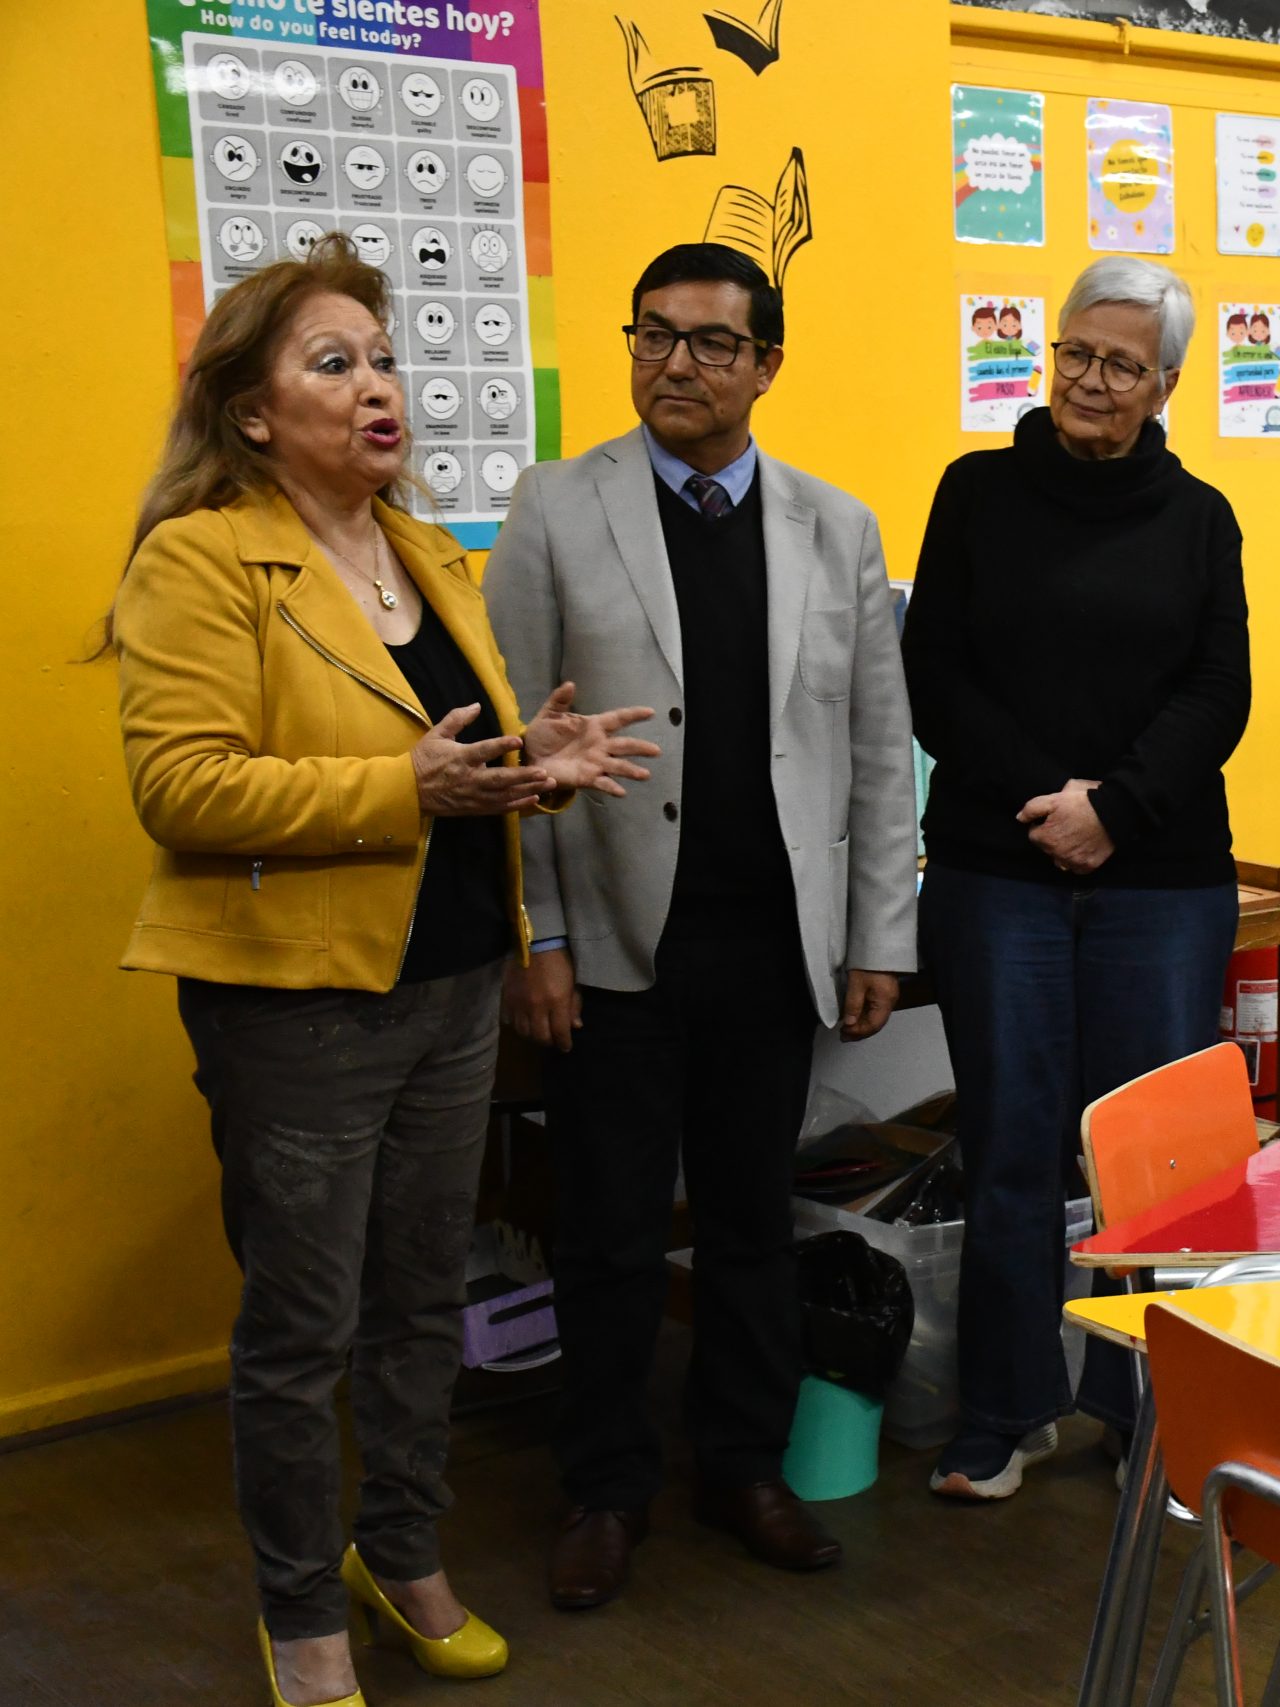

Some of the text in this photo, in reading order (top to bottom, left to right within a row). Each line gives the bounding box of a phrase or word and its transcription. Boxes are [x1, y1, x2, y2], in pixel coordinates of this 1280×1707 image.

[200, 9, 422, 50] How do you feel today?
[331, 0, 440, 29] sientes
[446, 3, 515, 41] hoy?
[995, 383, 1015, 396] PASO
